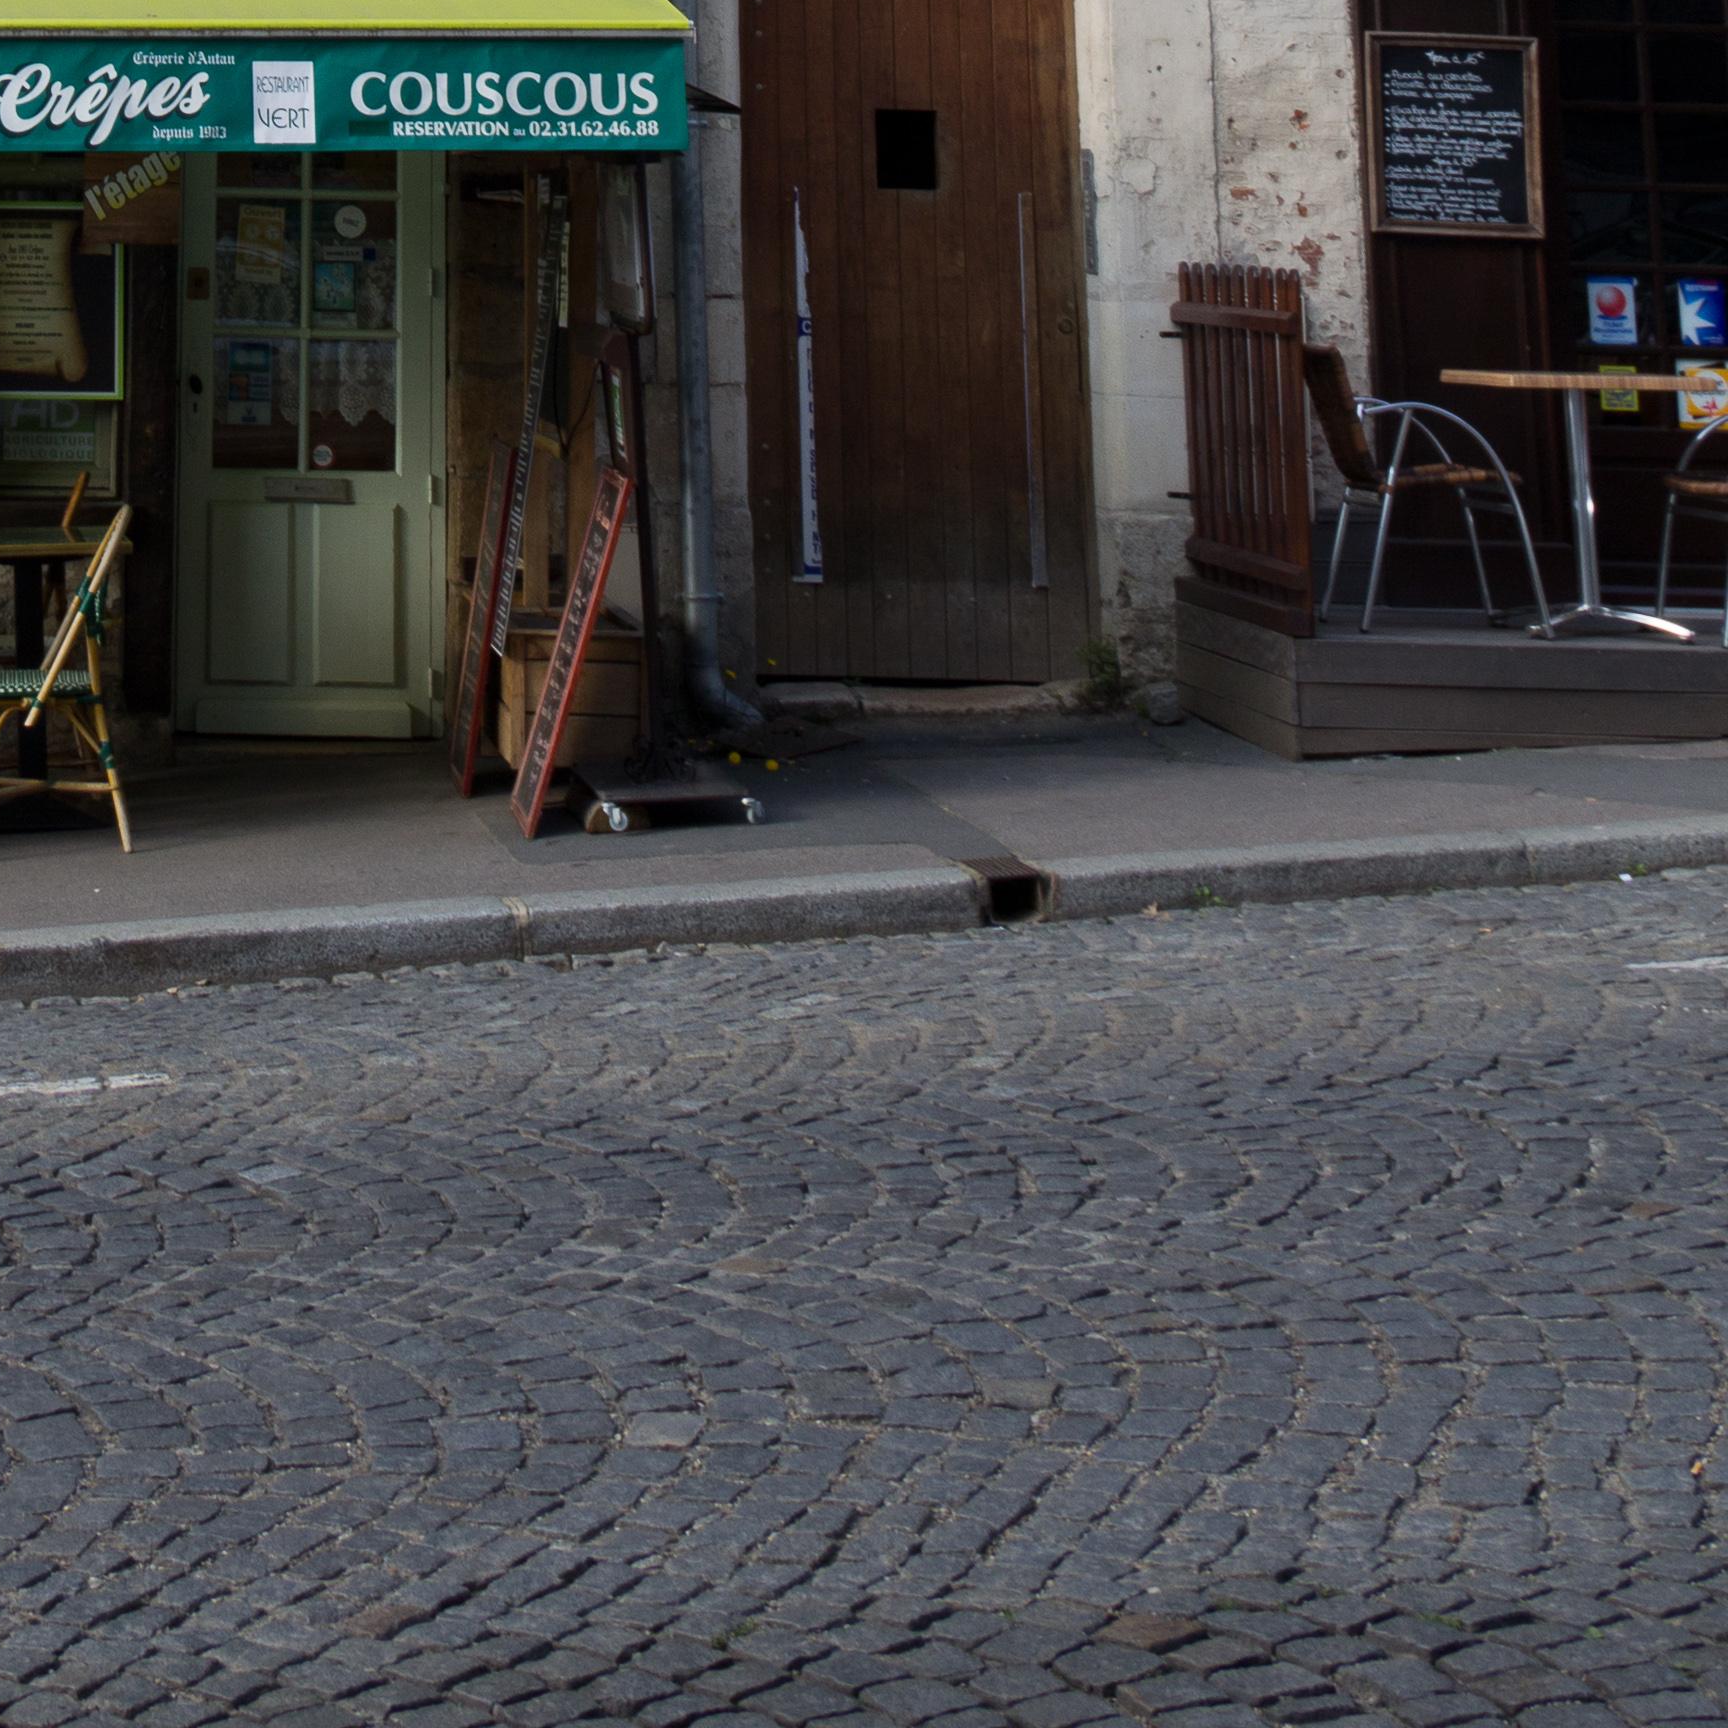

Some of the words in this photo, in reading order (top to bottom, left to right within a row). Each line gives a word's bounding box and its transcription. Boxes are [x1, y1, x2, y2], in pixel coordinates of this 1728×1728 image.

[133, 51, 184, 67] Crêperie
[256, 76, 309, 93] RESTAURANT
[350, 71, 658, 117] COUSCOUS
[257, 108, 310, 129] VERT
[152, 125, 194, 141] depuis
[392, 121, 509, 137] RESERVATION
[513, 127, 526, 137] au
[529, 120, 659, 137] 02.31.62.46.88
[84, 151, 182, 221] l'étage
[3, 433, 94, 446] AGRICULTURE
